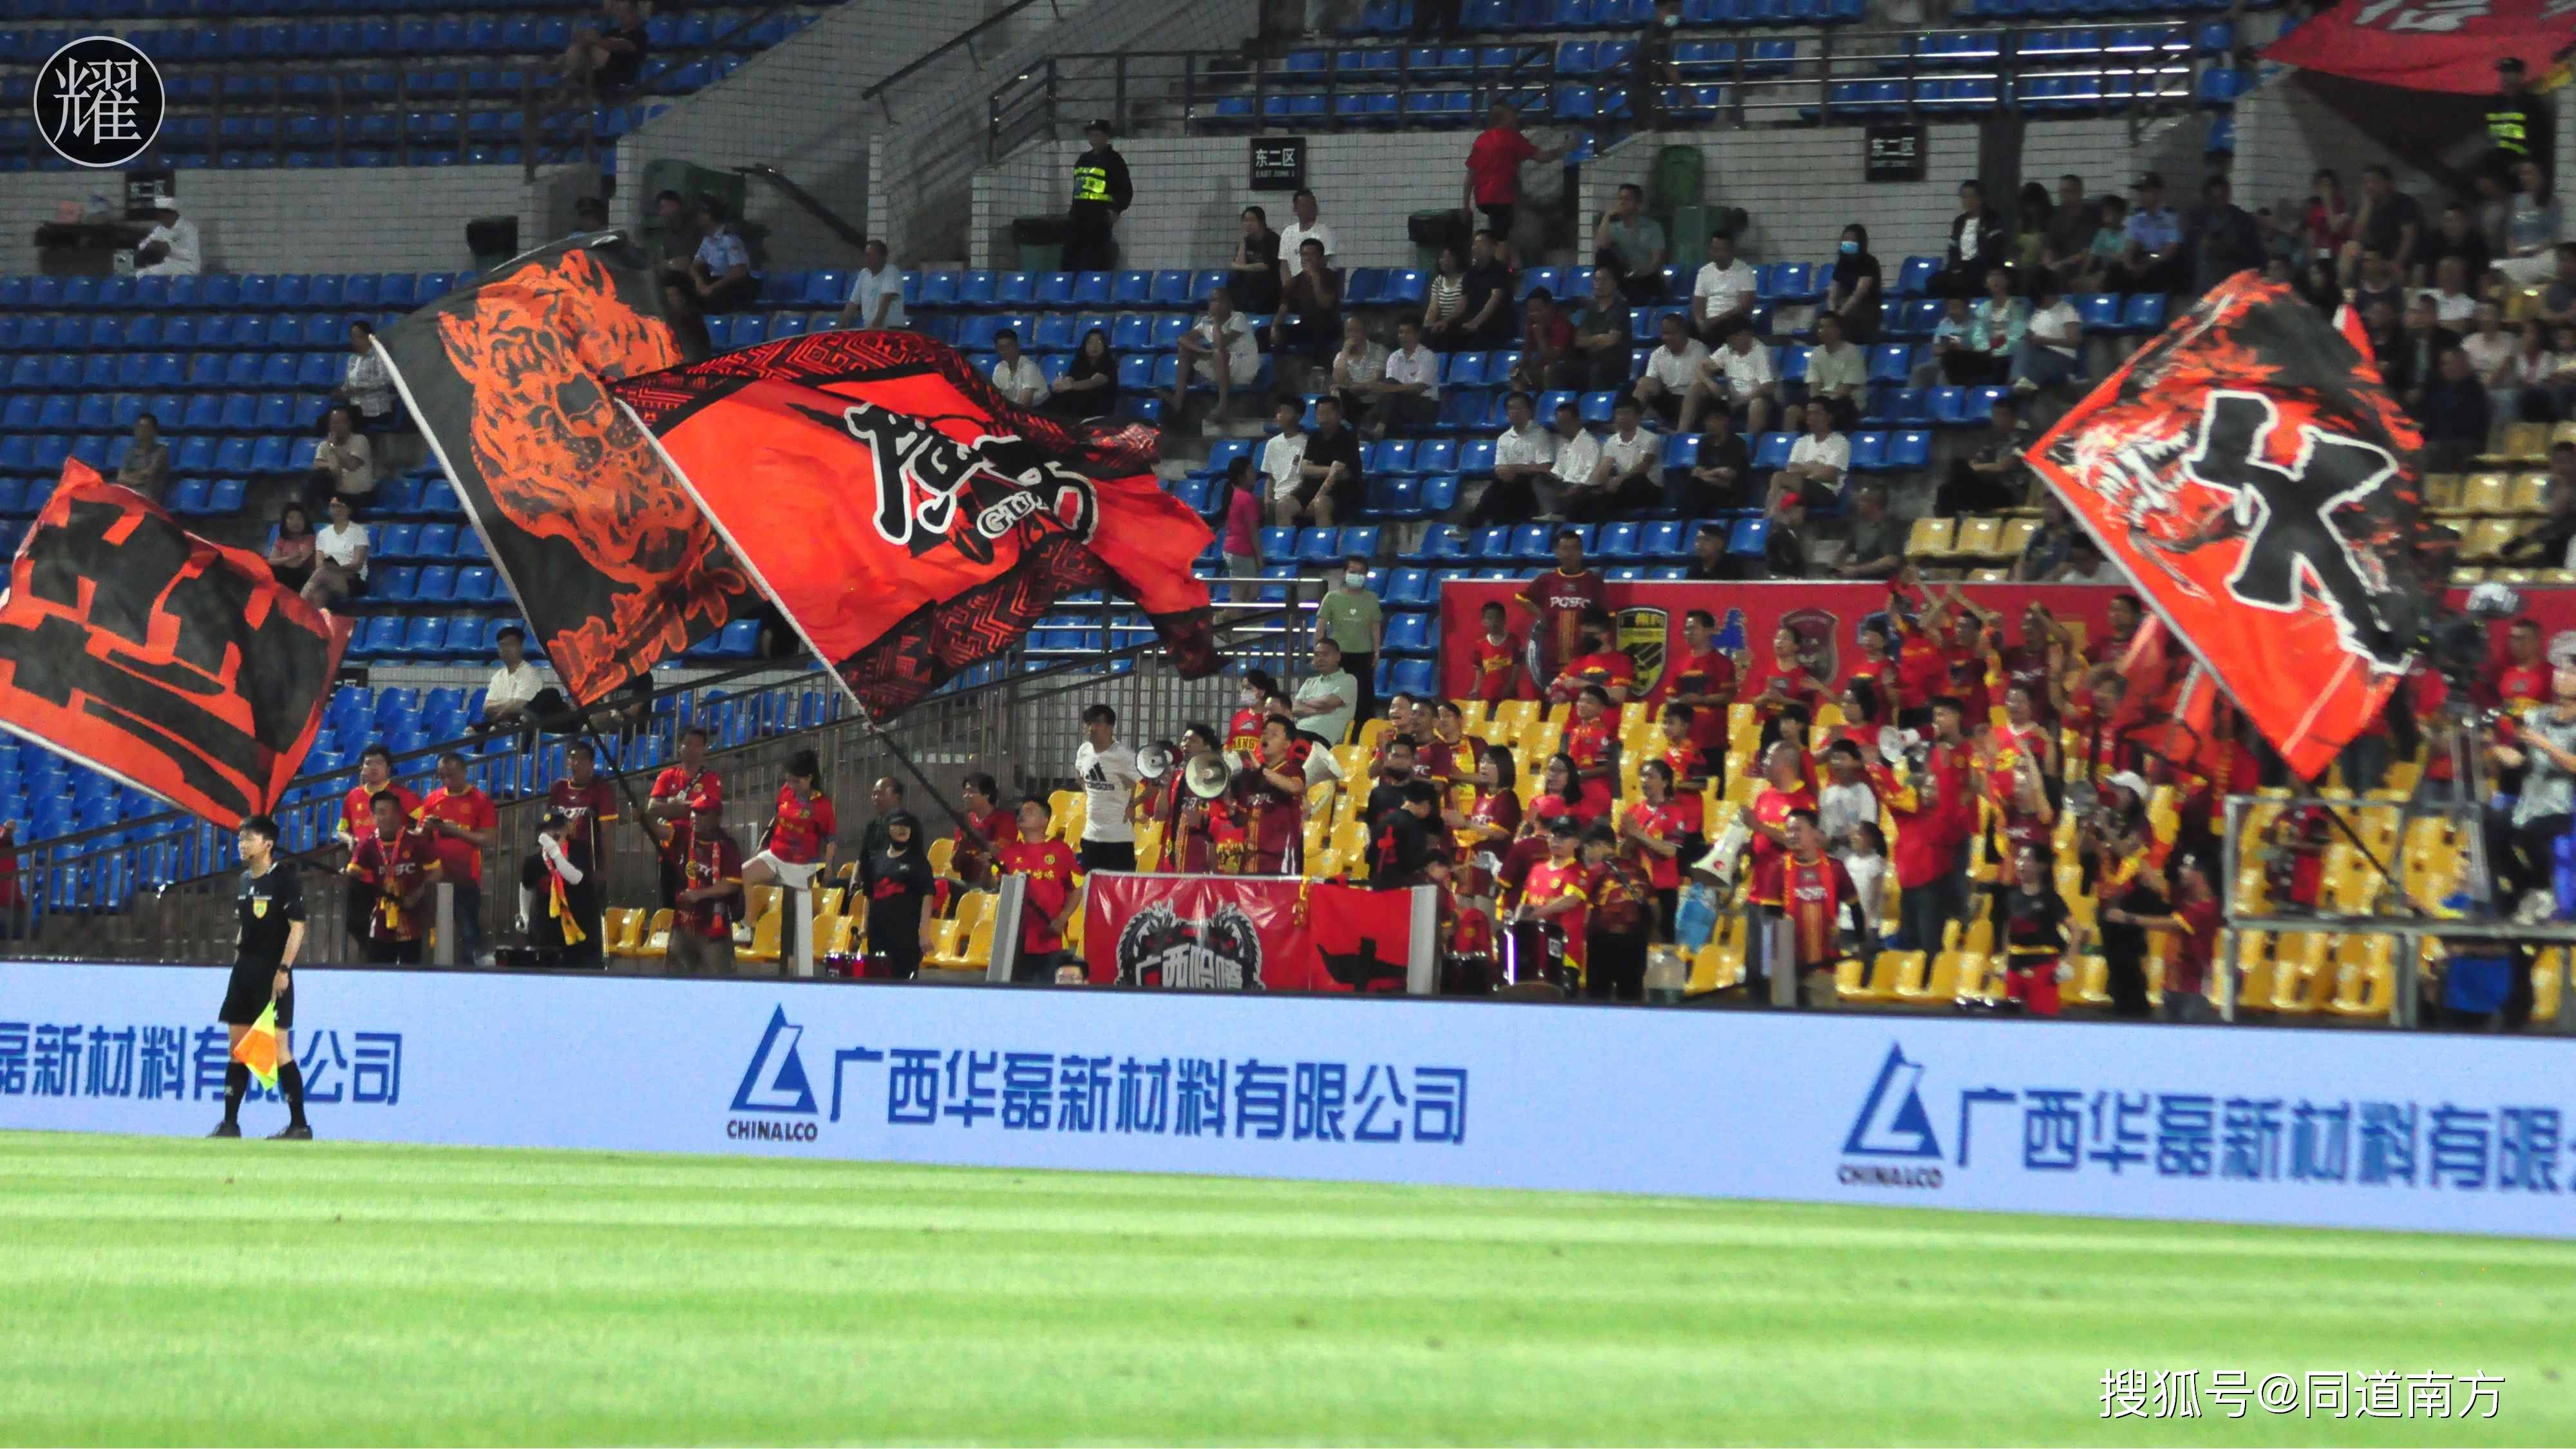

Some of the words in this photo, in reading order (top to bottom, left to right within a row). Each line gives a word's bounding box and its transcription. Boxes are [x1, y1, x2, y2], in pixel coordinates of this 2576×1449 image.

[1255, 147, 1296, 168] 东二区
[829, 1046, 1468, 1145] 广西华磊新材料有限公司
[726, 1120, 819, 1142] CHINALCO
[1958, 1086, 2576, 1193] 广西华磊新材料有限
[1837, 1163, 1944, 1189] CHINALCO
